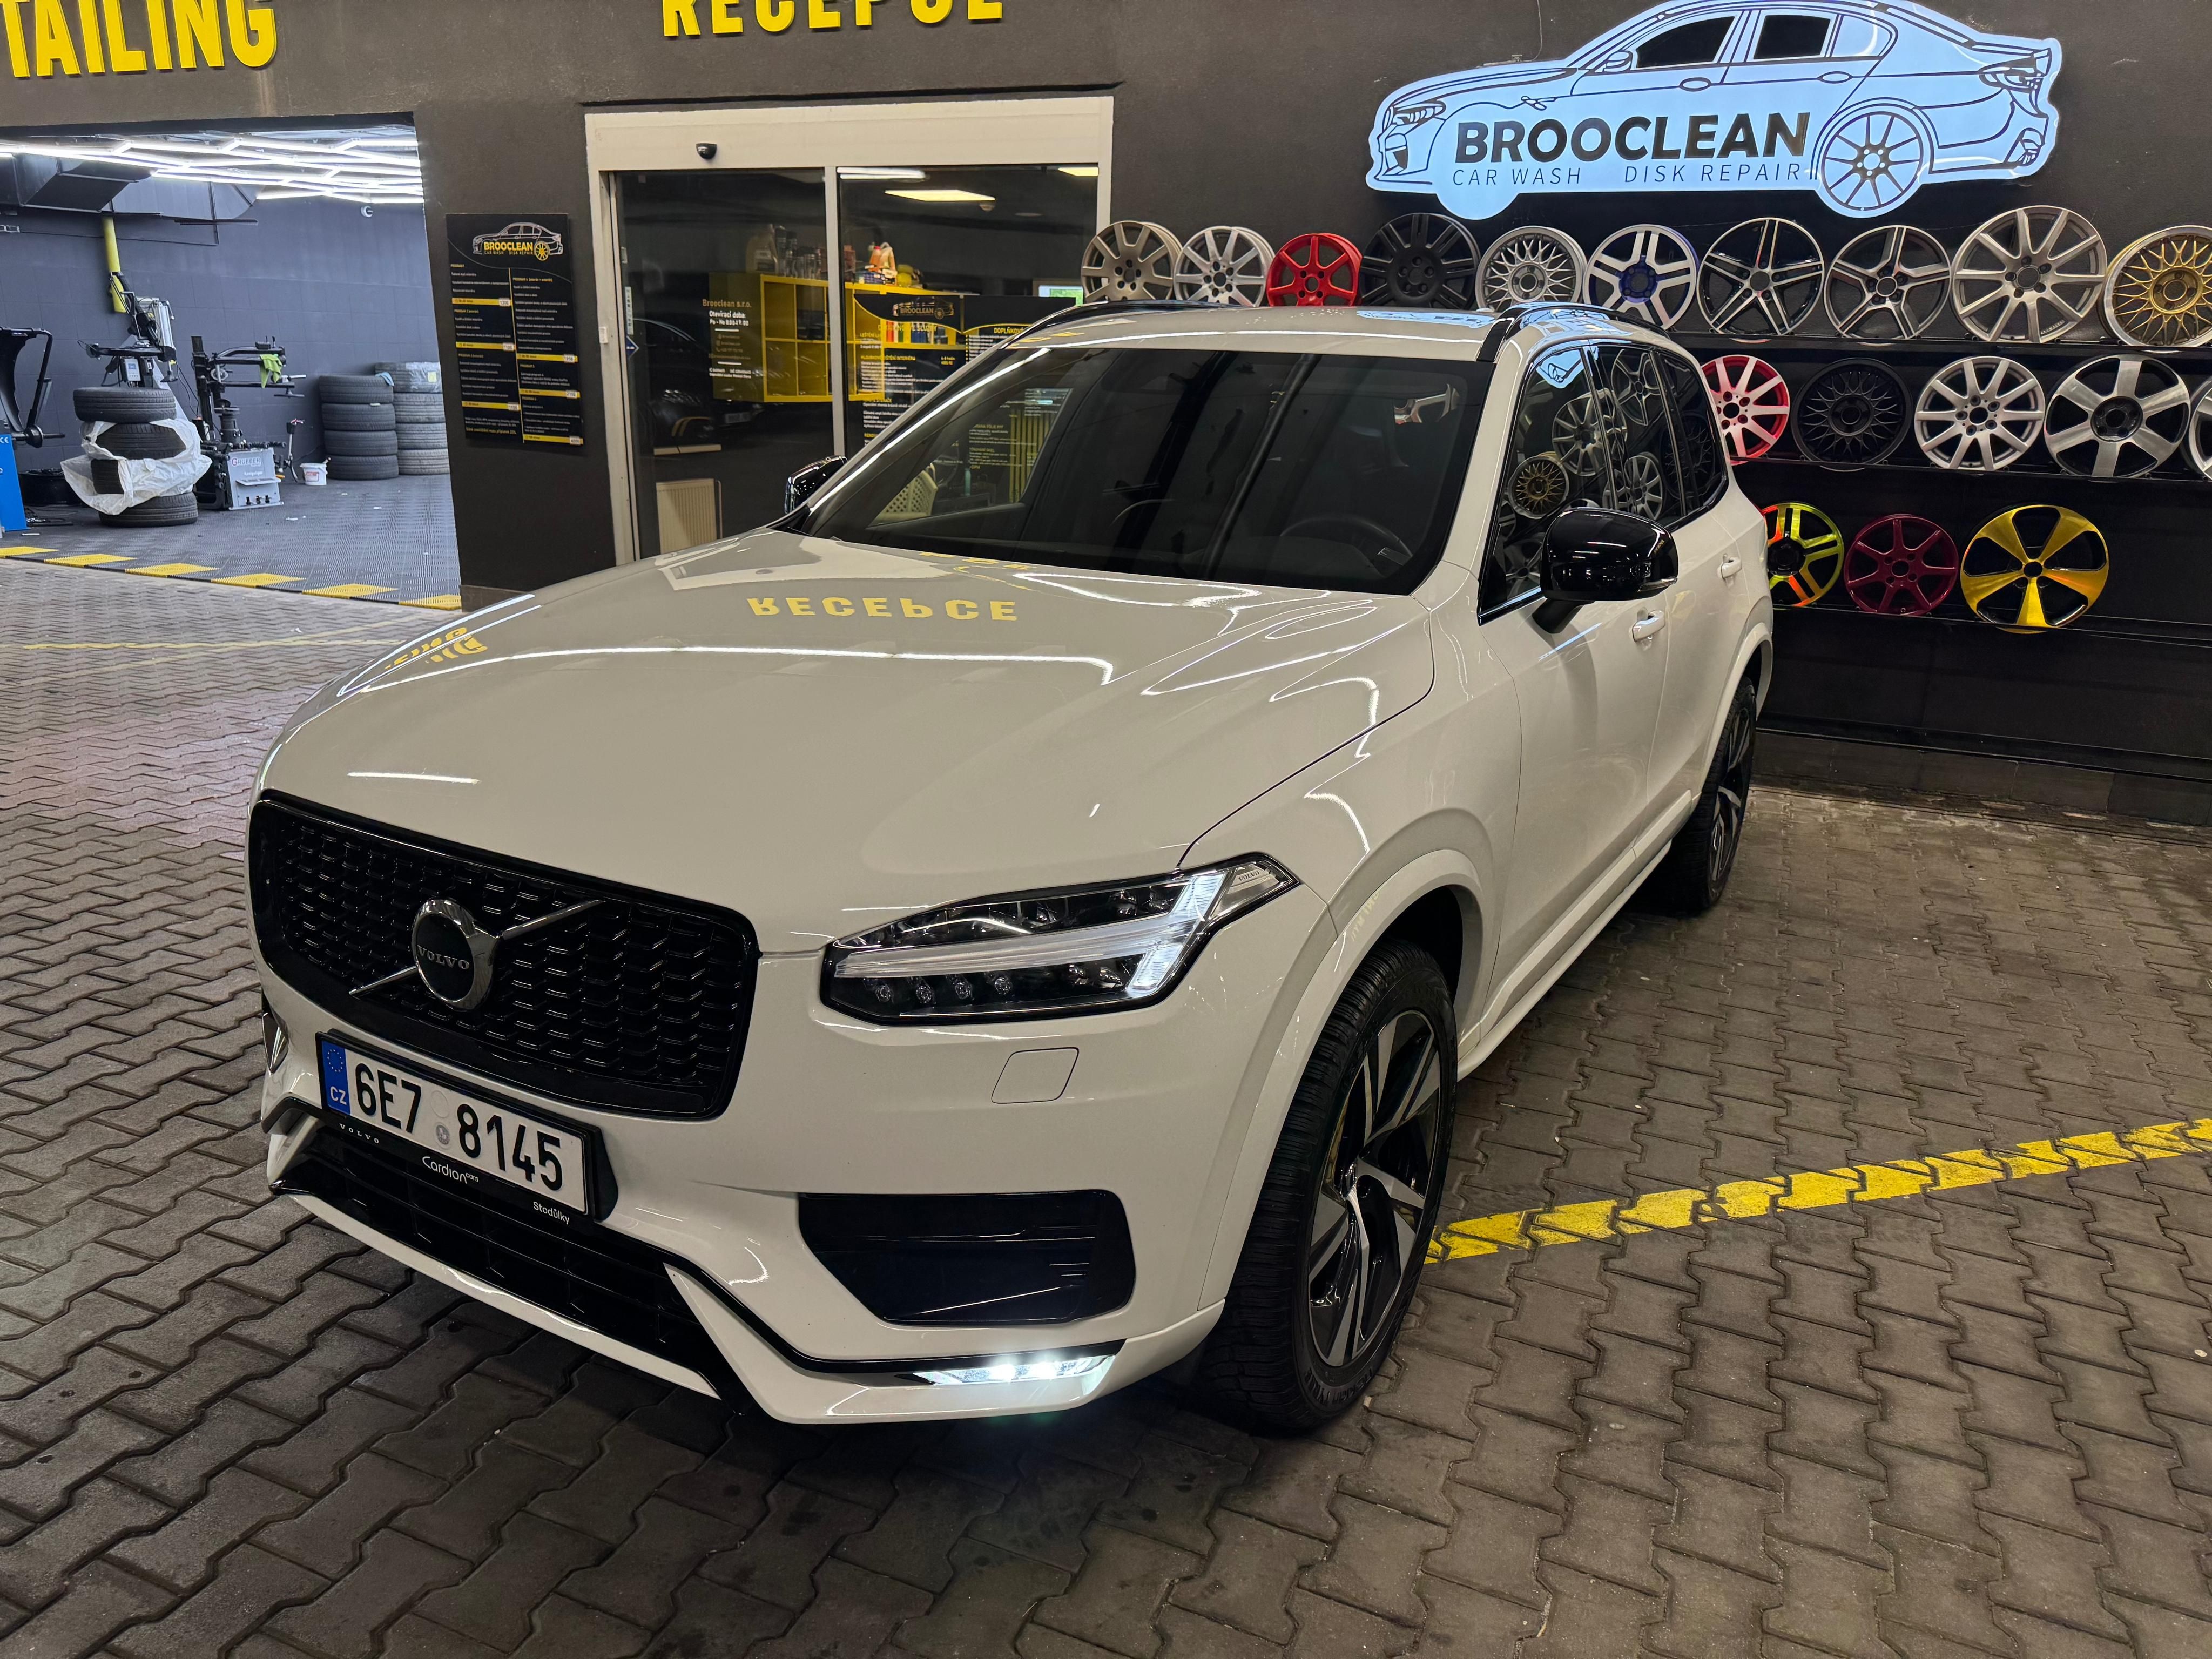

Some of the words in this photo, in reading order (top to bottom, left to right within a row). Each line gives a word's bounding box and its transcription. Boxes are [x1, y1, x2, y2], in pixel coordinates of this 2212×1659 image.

[1455, 112, 1810, 164] BROOCLEAN
[1453, 168, 1498, 186] CAR
[1512, 167, 1581, 185] WASH
[1624, 164, 1685, 184] DISK
[1701, 163, 1801, 183] REPAIR
[484, 241, 533, 251] BROOCLEAN
[702, 299, 735, 307] Brooclean
[1238, 871, 1260, 881] VOLVO
[417, 945, 470, 970] VOLVO
[329, 1086, 347, 1106] CZ
[339, 1123, 379, 1144] VOLVO
[355, 1063, 422, 1134] 6E7
[457, 1103, 563, 1191] 8145
[532, 1201, 570, 1225] Stodůlky
